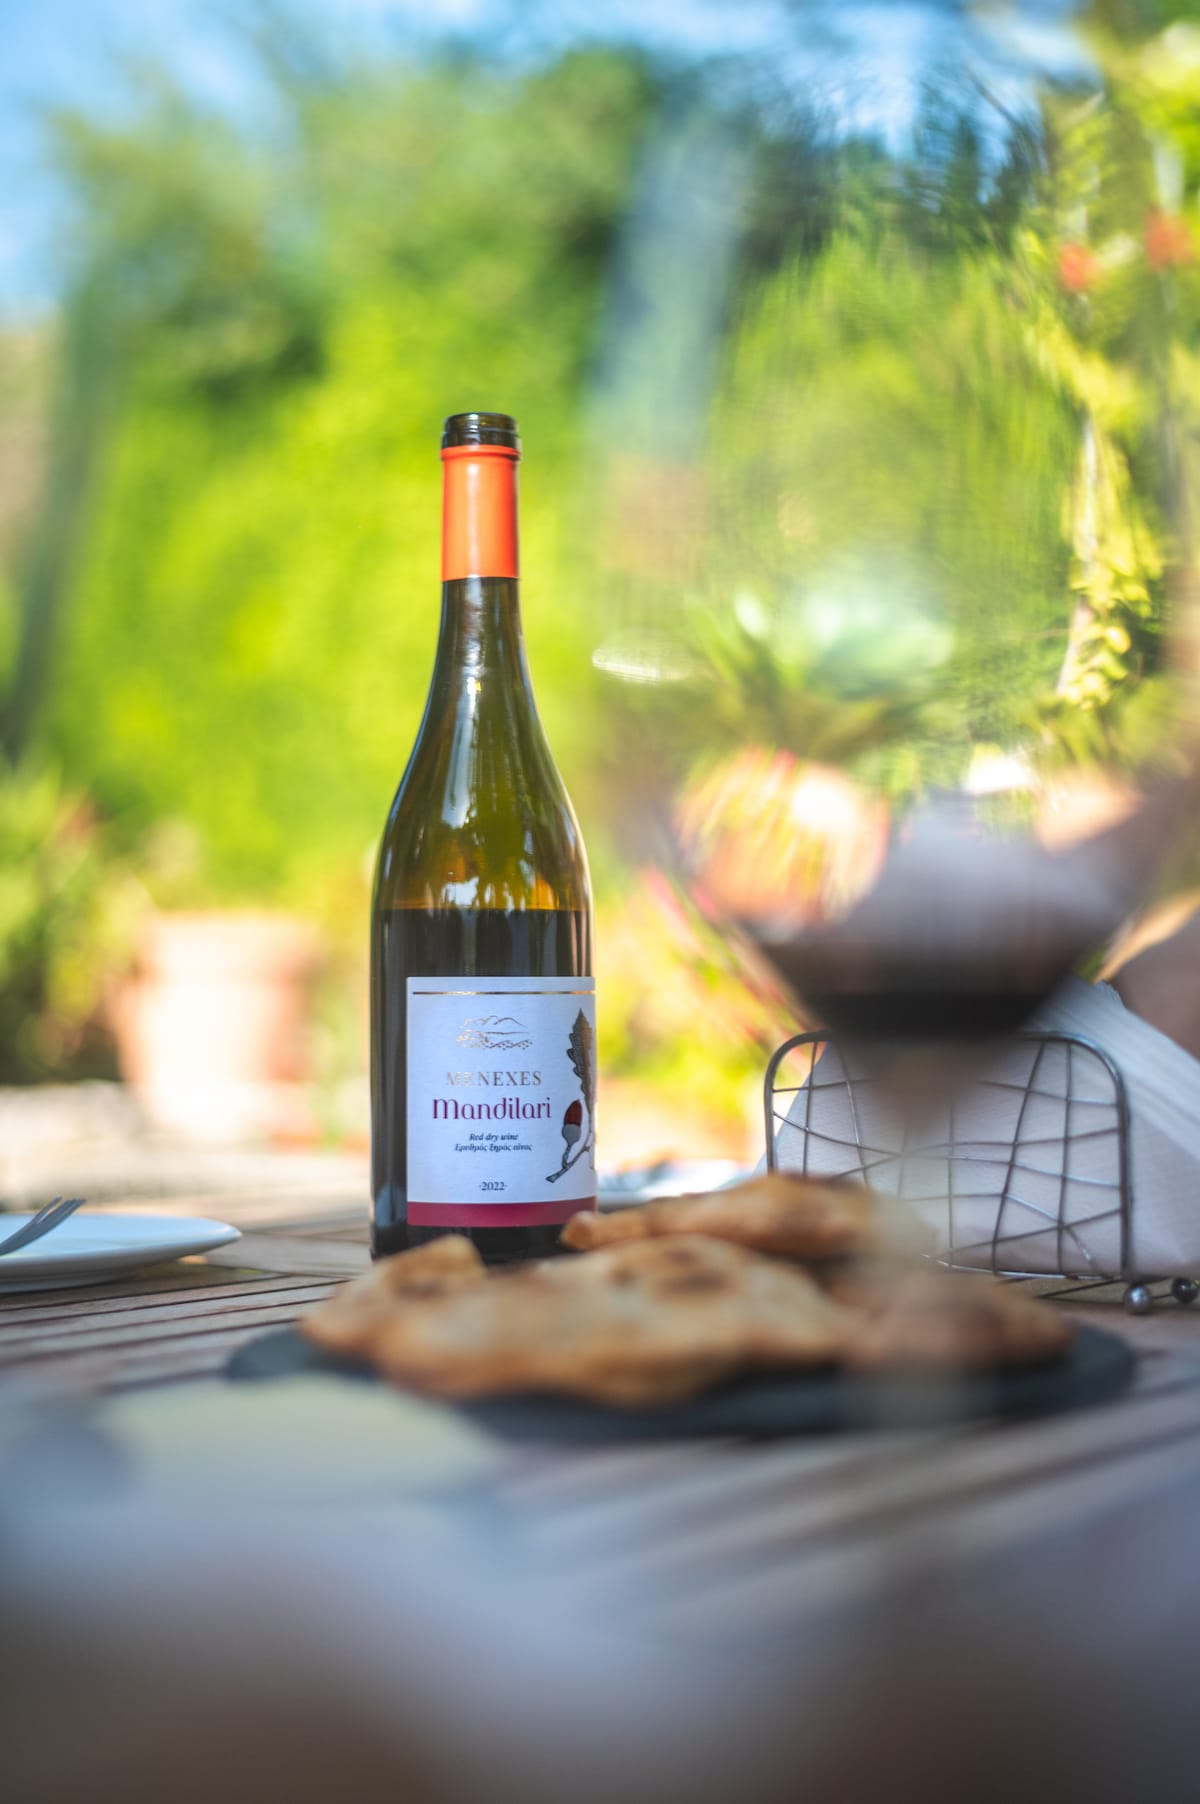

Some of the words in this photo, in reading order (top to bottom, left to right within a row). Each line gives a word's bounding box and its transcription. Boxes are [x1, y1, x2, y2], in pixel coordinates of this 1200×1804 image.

[446, 1071, 542, 1087] MENEXES
[433, 1097, 552, 1119] Mandilari
[469, 1133, 484, 1141] Red
[485, 1133, 499, 1142] dry
[501, 1133, 519, 1141] wine
